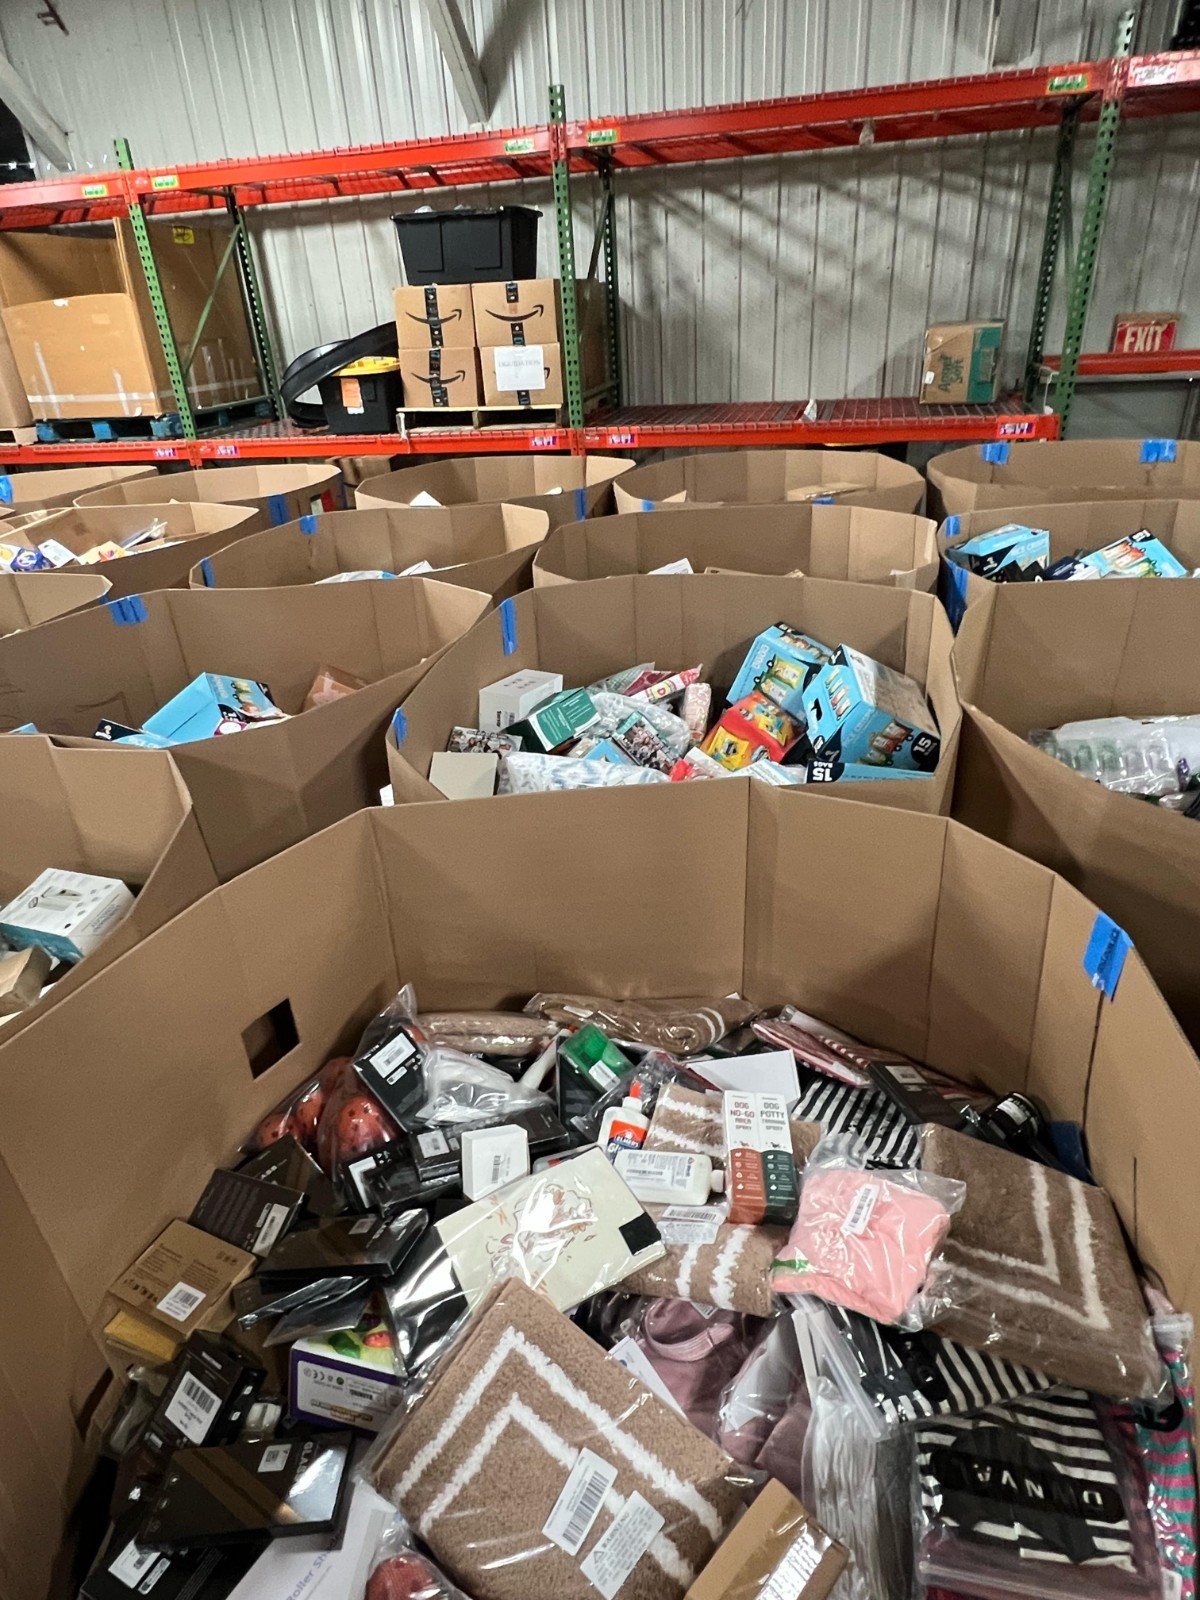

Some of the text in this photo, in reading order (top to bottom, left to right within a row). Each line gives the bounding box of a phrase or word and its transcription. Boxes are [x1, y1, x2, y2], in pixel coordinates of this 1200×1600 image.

[1123, 325, 1163, 352] EXIT
[913, 736, 933, 754] 15
[814, 761, 833, 769] BAGS
[812, 767, 833, 783] 15
[734, 1101, 750, 1110] DOG
[763, 1102, 780, 1111] DOG
[730, 1110, 755, 1119] NO-GO
[760, 1110, 785, 1119] POTTY
[602, 1511, 631, 1549] WARNING
